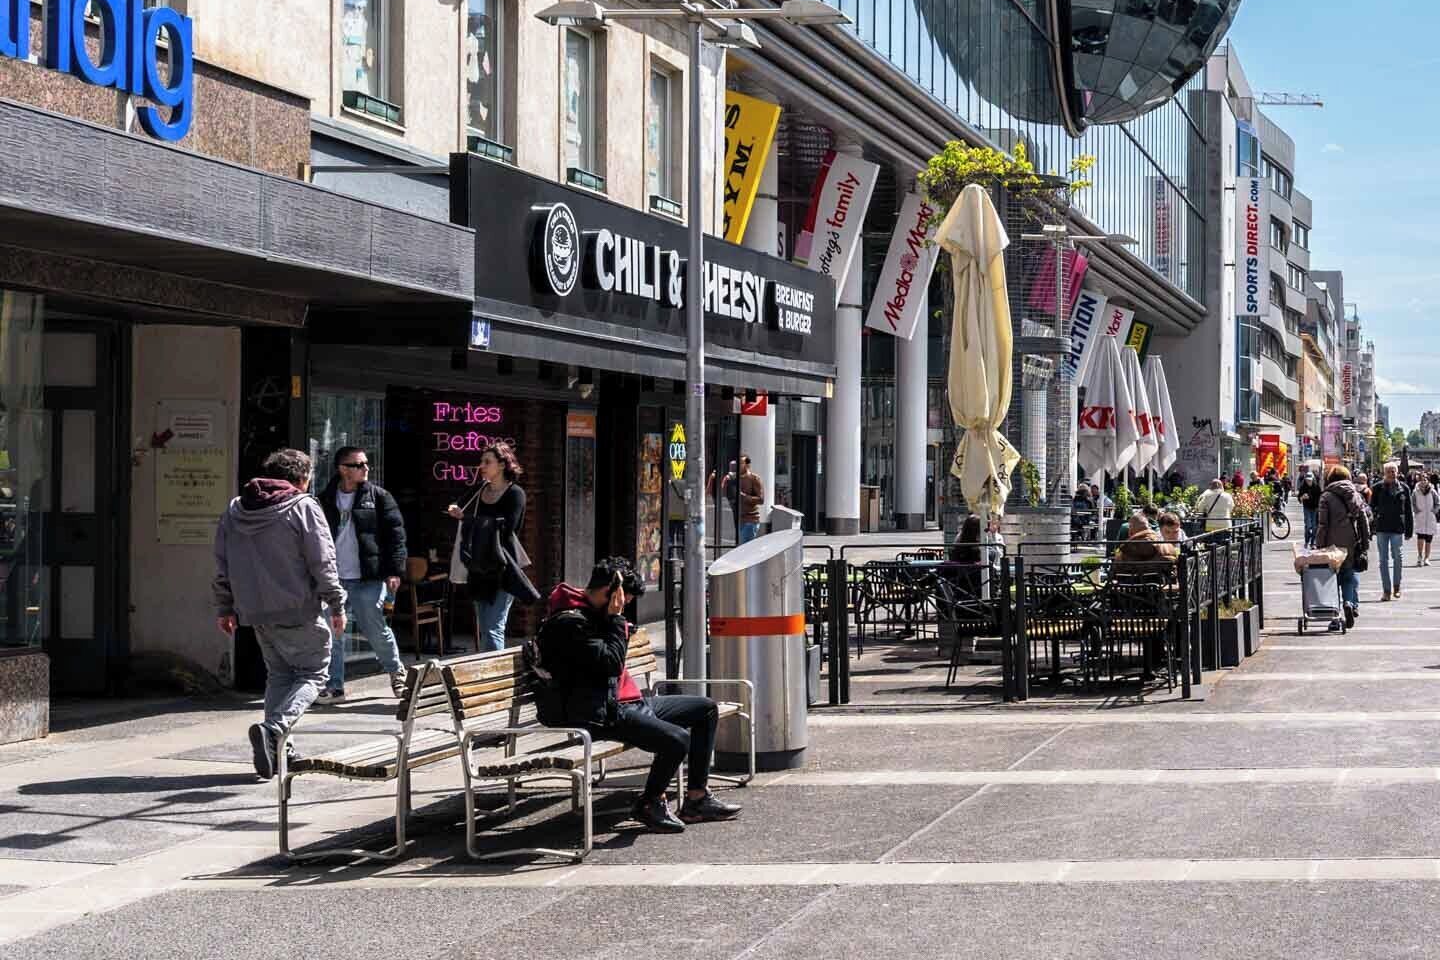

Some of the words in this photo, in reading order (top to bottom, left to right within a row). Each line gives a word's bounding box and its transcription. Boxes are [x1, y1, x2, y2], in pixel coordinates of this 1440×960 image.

[826, 171, 861, 230] family
[596, 228, 661, 301] CHILI
[668, 249, 683, 309] &
[702, 260, 766, 324] HEESY
[775, 283, 815, 313] BREAKFAST
[883, 269, 914, 332] Media
[1246, 257, 1259, 314] SPORTS
[779, 307, 784, 329] &
[785, 310, 812, 335] BURGER
[1069, 294, 1098, 372] ACTION
[432, 401, 502, 423] Fries
[432, 460, 481, 487] Guy
